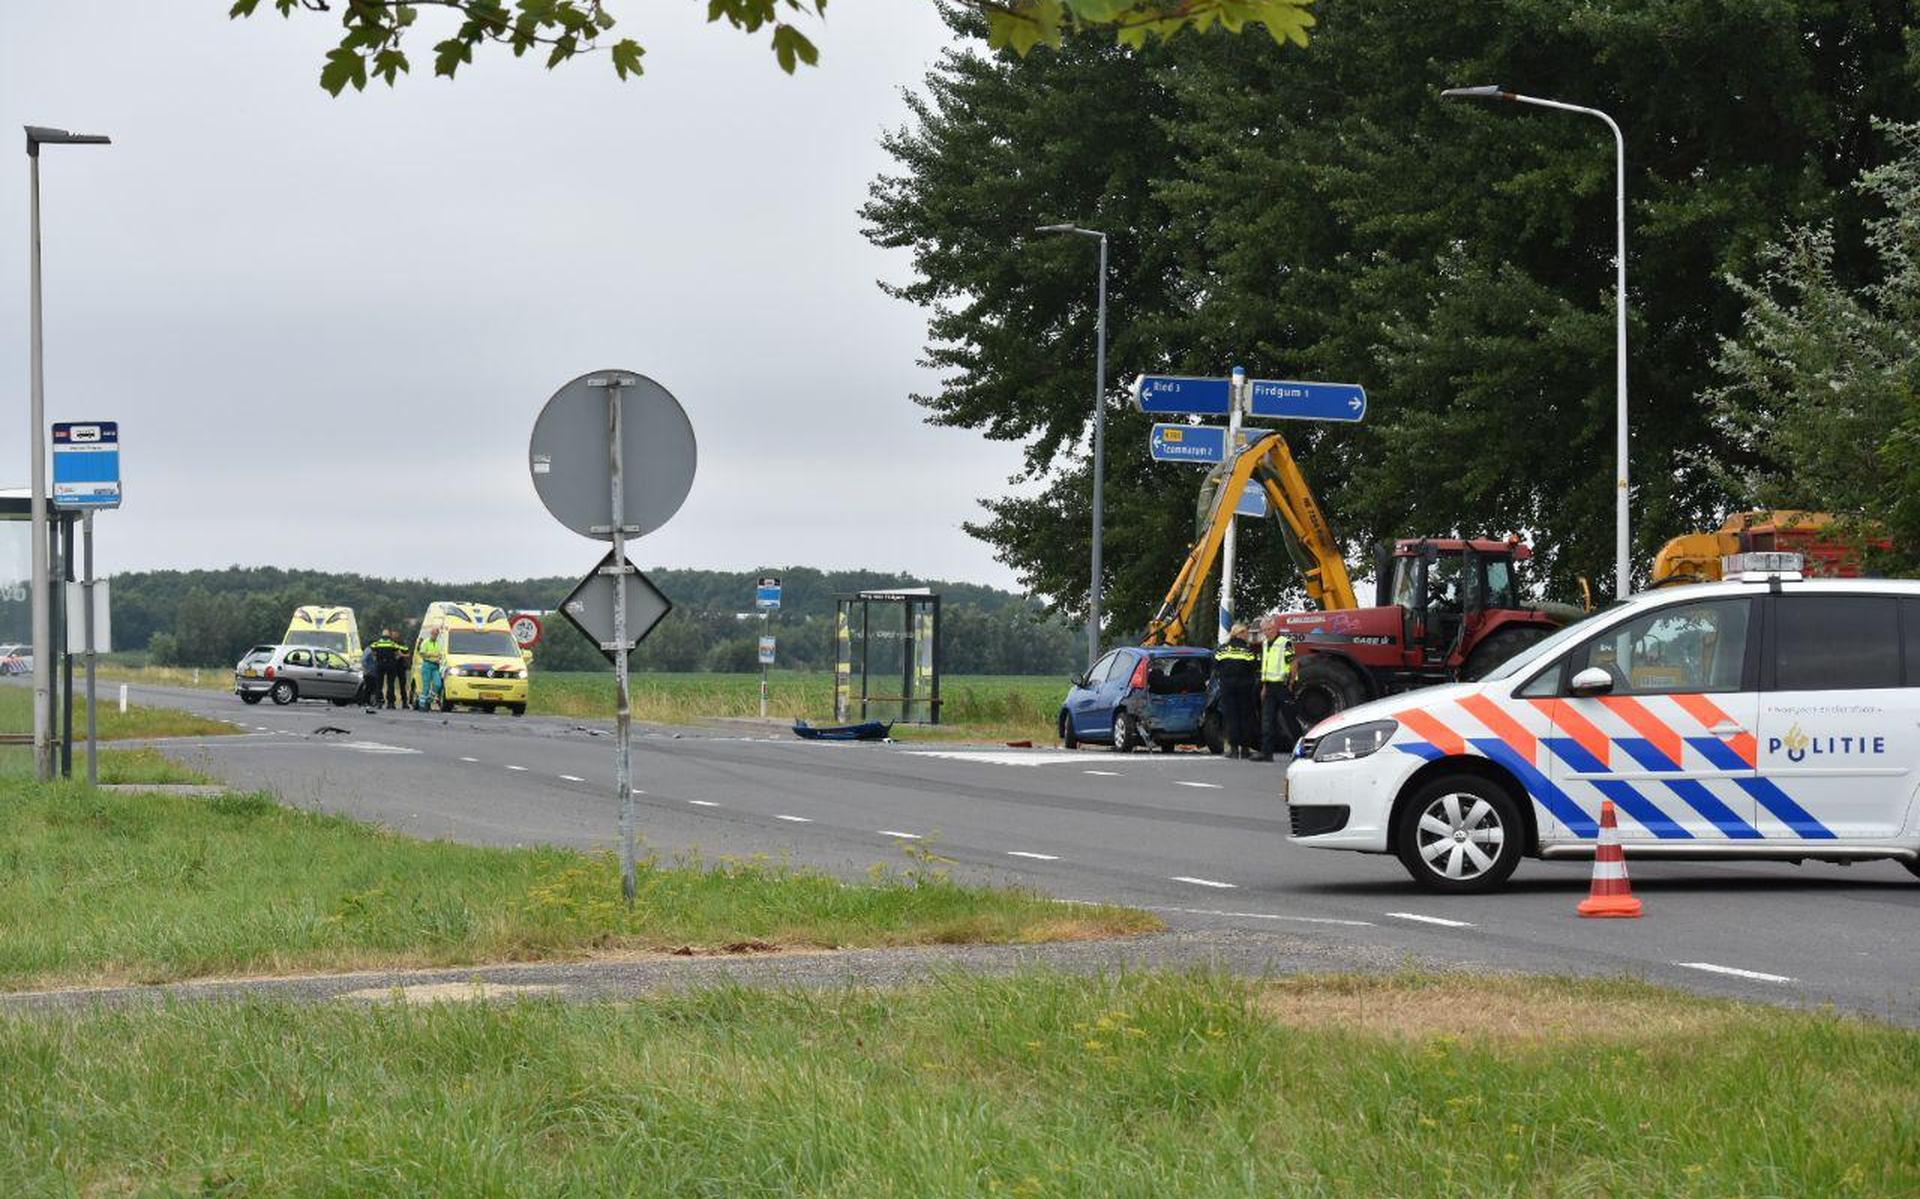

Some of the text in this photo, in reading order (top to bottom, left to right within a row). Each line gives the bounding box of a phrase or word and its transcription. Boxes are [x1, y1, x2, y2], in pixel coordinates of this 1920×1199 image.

[1153, 381, 1174, 391] Ried
[1255, 384, 1301, 398] Firdgum
[1353, 636, 1379, 645] CASE
[1769, 737, 1885, 762] POLITIE
